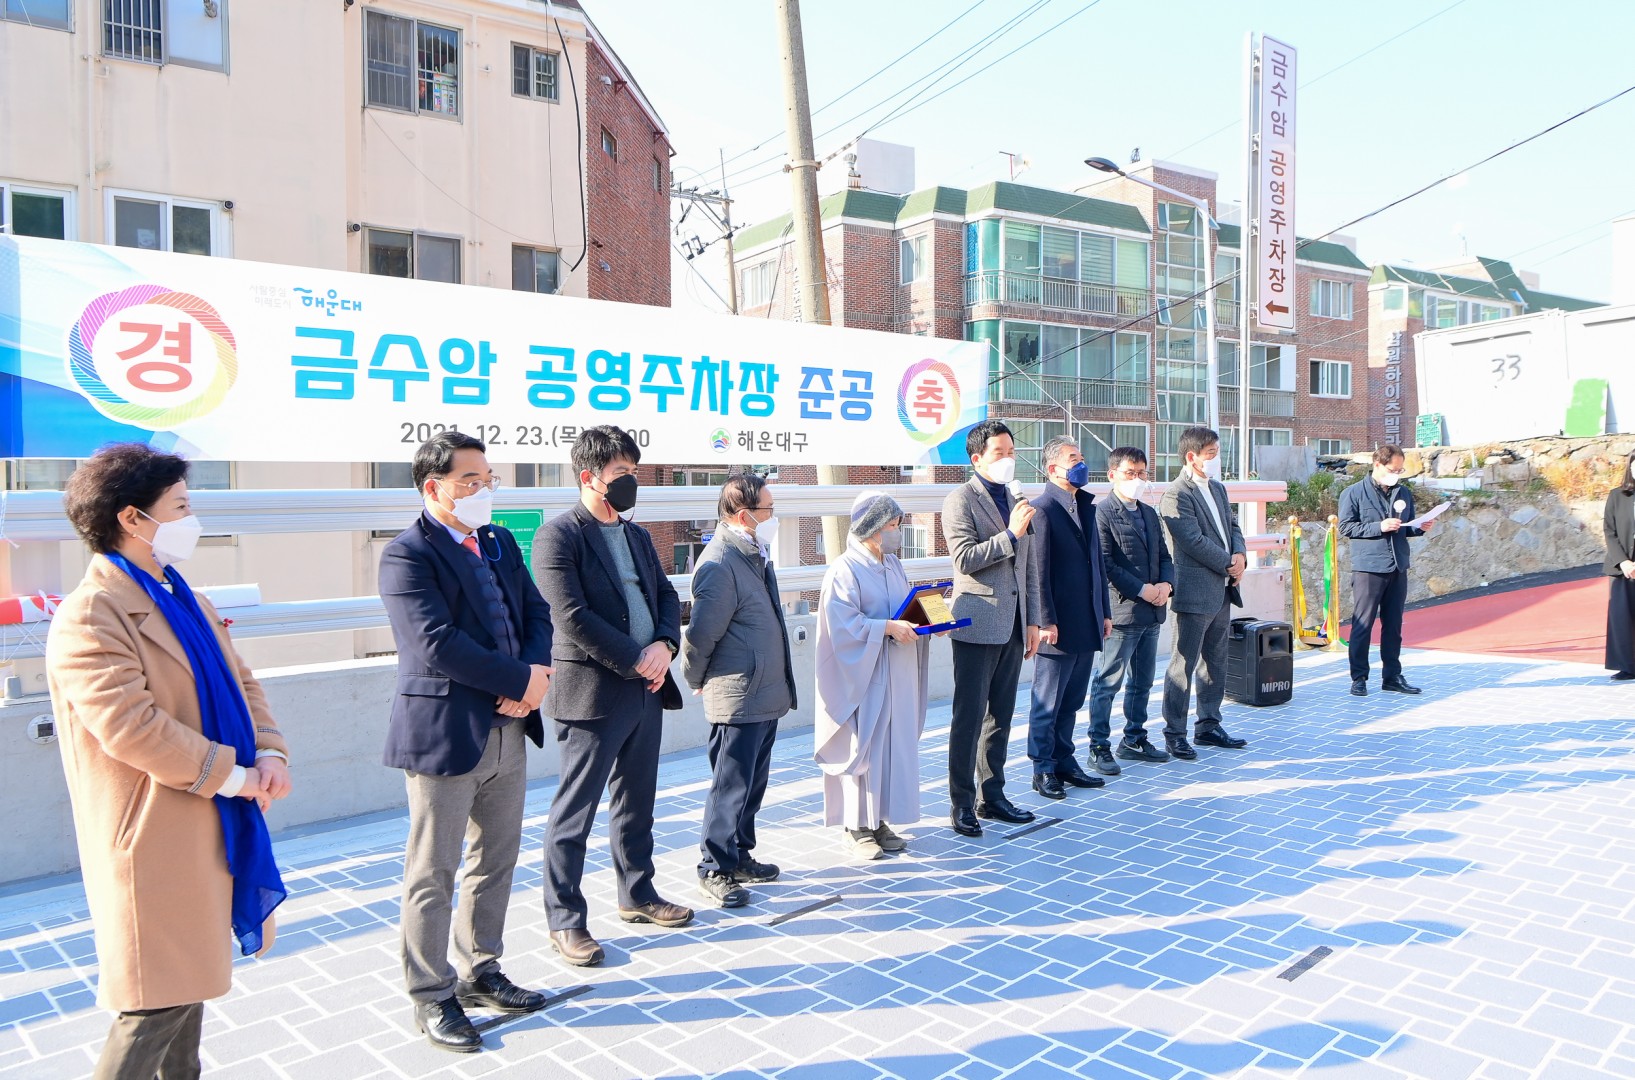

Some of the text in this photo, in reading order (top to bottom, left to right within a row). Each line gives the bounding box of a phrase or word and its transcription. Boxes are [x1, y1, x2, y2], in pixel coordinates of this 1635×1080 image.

[1268, 50, 1288, 293] 금수암 공영주차장
[293, 287, 362, 317] 해운대
[115, 321, 193, 393] 경
[1491, 354, 1521, 382] 33
[291, 325, 874, 421] 금수암 공영주차장 준공
[913, 379, 946, 425] 축
[476, 425, 508, 445] 12.
[738, 430, 808, 452] 해운대구
[1261, 680, 1290, 693] MIPRO
